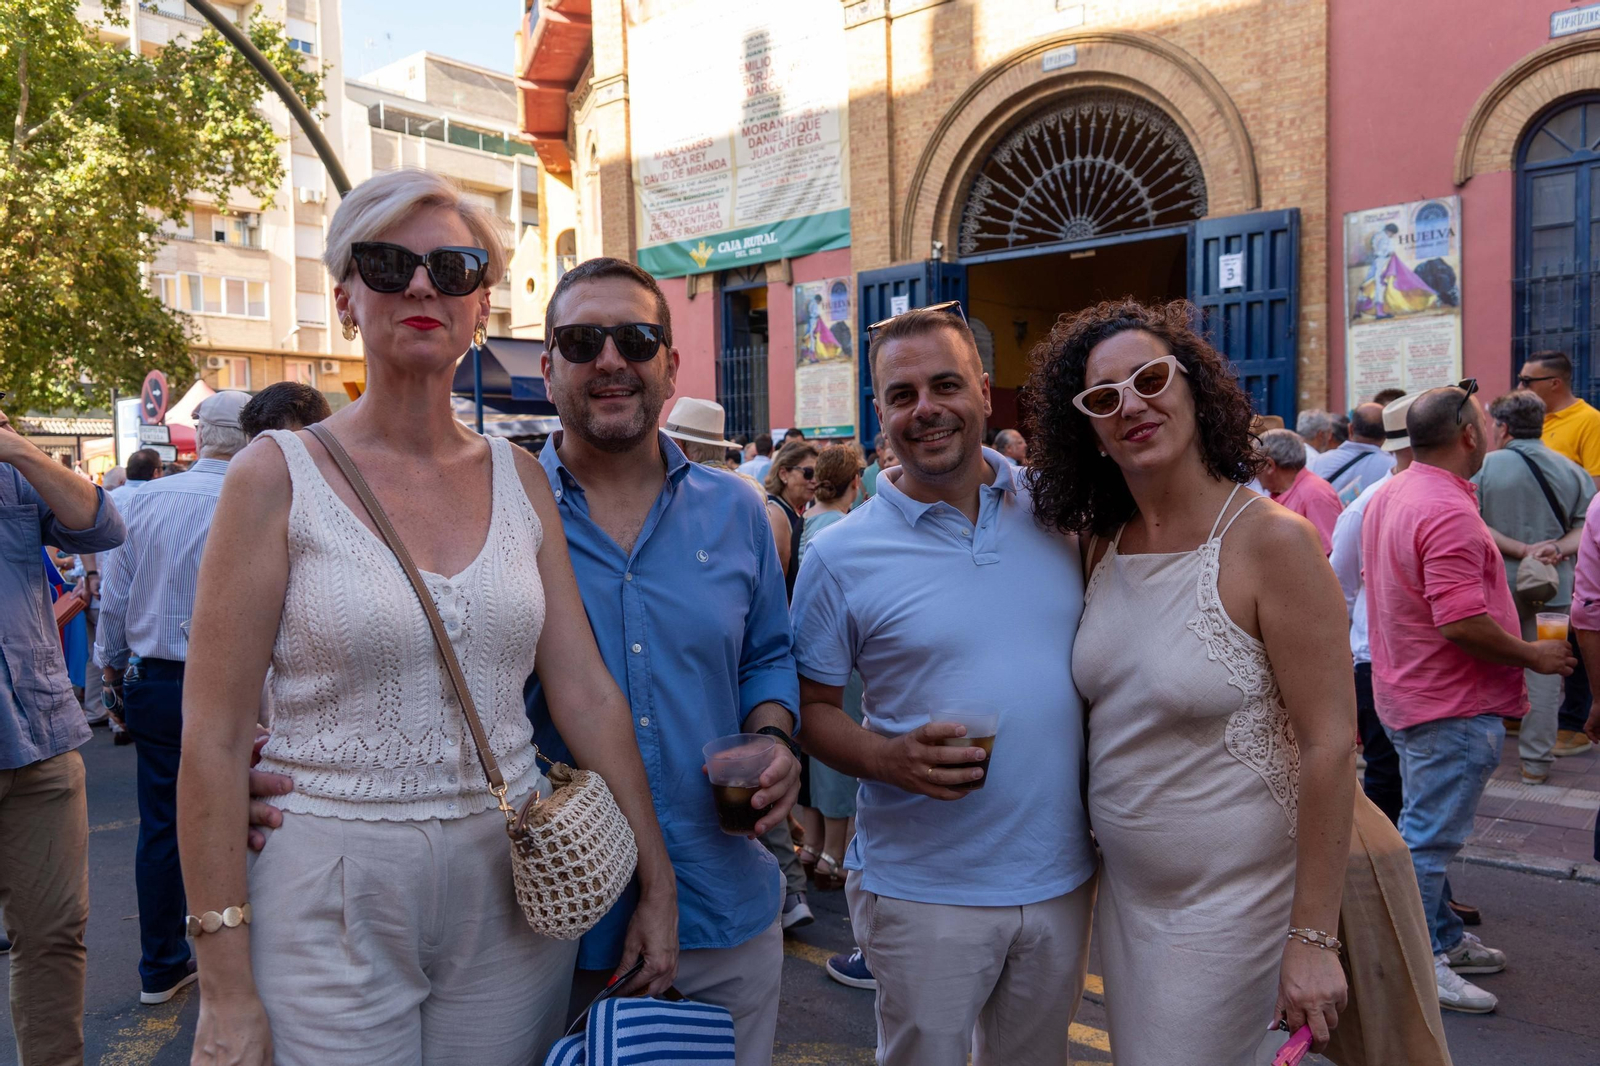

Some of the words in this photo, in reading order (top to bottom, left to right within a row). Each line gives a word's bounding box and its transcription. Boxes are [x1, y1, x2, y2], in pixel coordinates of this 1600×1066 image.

[742, 115, 796, 138] MORANTE
[748, 130, 783, 149] DANIEL
[786, 117, 822, 138] LUQUE
[751, 145, 776, 161] JUAN
[778, 132, 822, 152] ORTEGA
[662, 155, 688, 171] ROCA
[689, 151, 706, 164] REY
[643, 171, 670, 187] DAVID
[672, 168, 684, 180] DE
[686, 158, 728, 176] MIRANDA
[650, 207, 686, 222] SERGIO
[651, 218, 677, 232] DIEGO
[678, 210, 720, 226] VENTURA
[684, 219, 723, 235] ROMERO
[1398, 227, 1456, 245] HUELVA
[718, 239, 742, 253] CAJA
[743, 232, 778, 249] RURAL
[735, 249, 748, 258] DEL
[749, 247, 762, 255] SUR
[1227, 267, 1235, 280] 3
